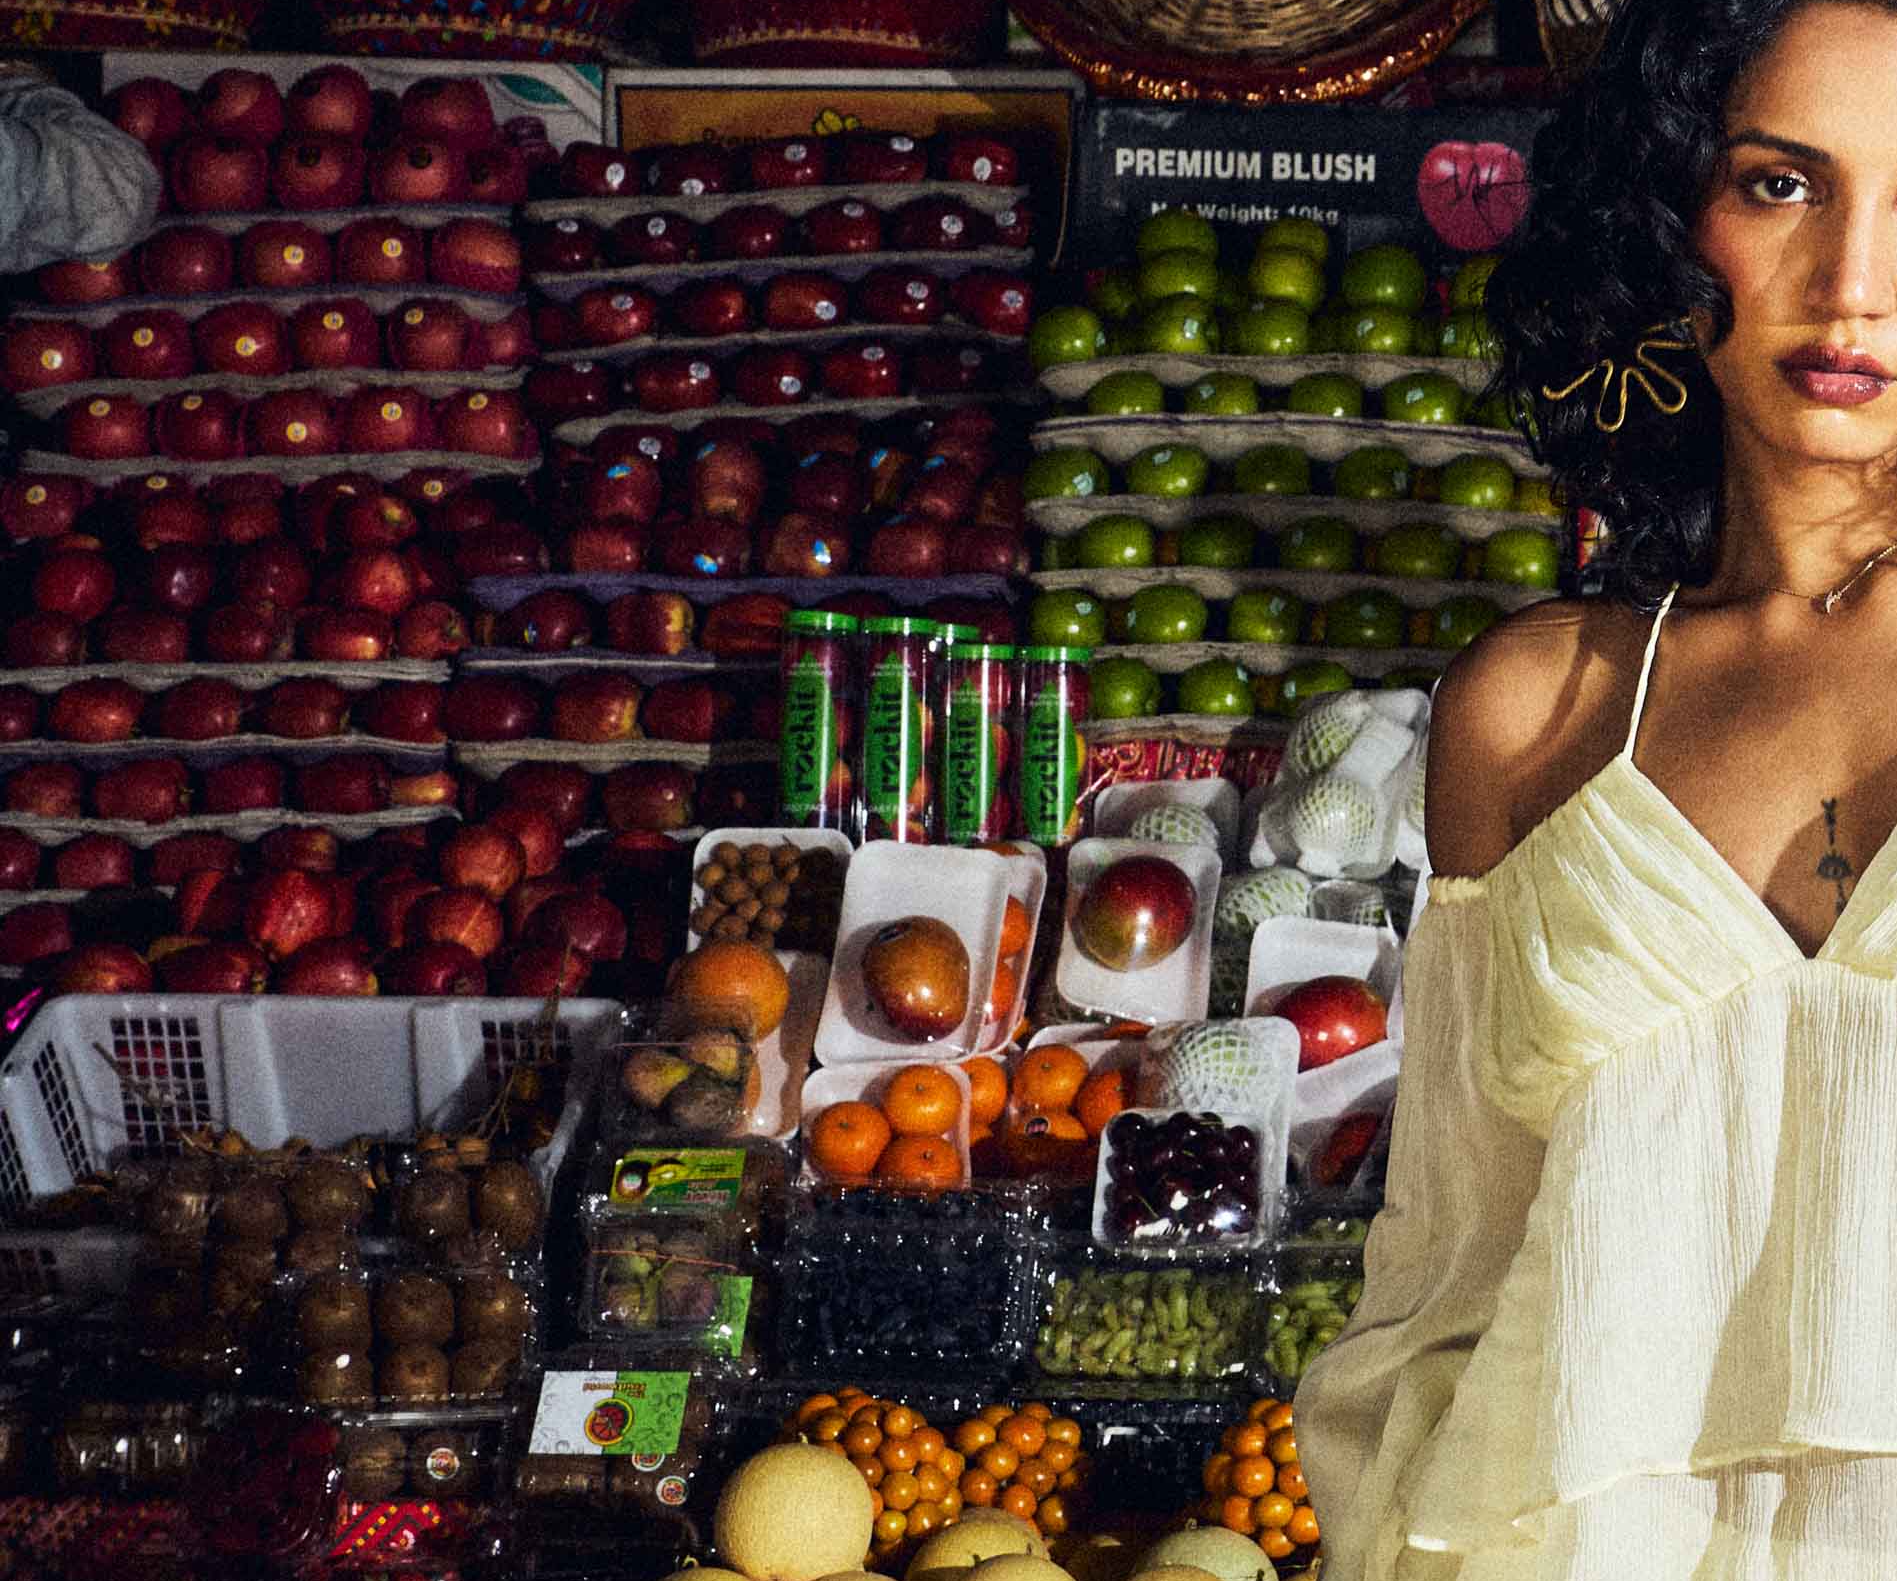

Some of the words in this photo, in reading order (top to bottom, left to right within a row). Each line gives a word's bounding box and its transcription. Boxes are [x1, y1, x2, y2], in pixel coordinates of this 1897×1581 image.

[1115, 148, 1261, 179] PREMIUM
[1272, 152, 1376, 182] BLUSH
[791, 691, 816, 794] rockit
[875, 691, 901, 794] rockit
[952, 718, 978, 820] rockit
[1031, 720, 1058, 822] rockit
